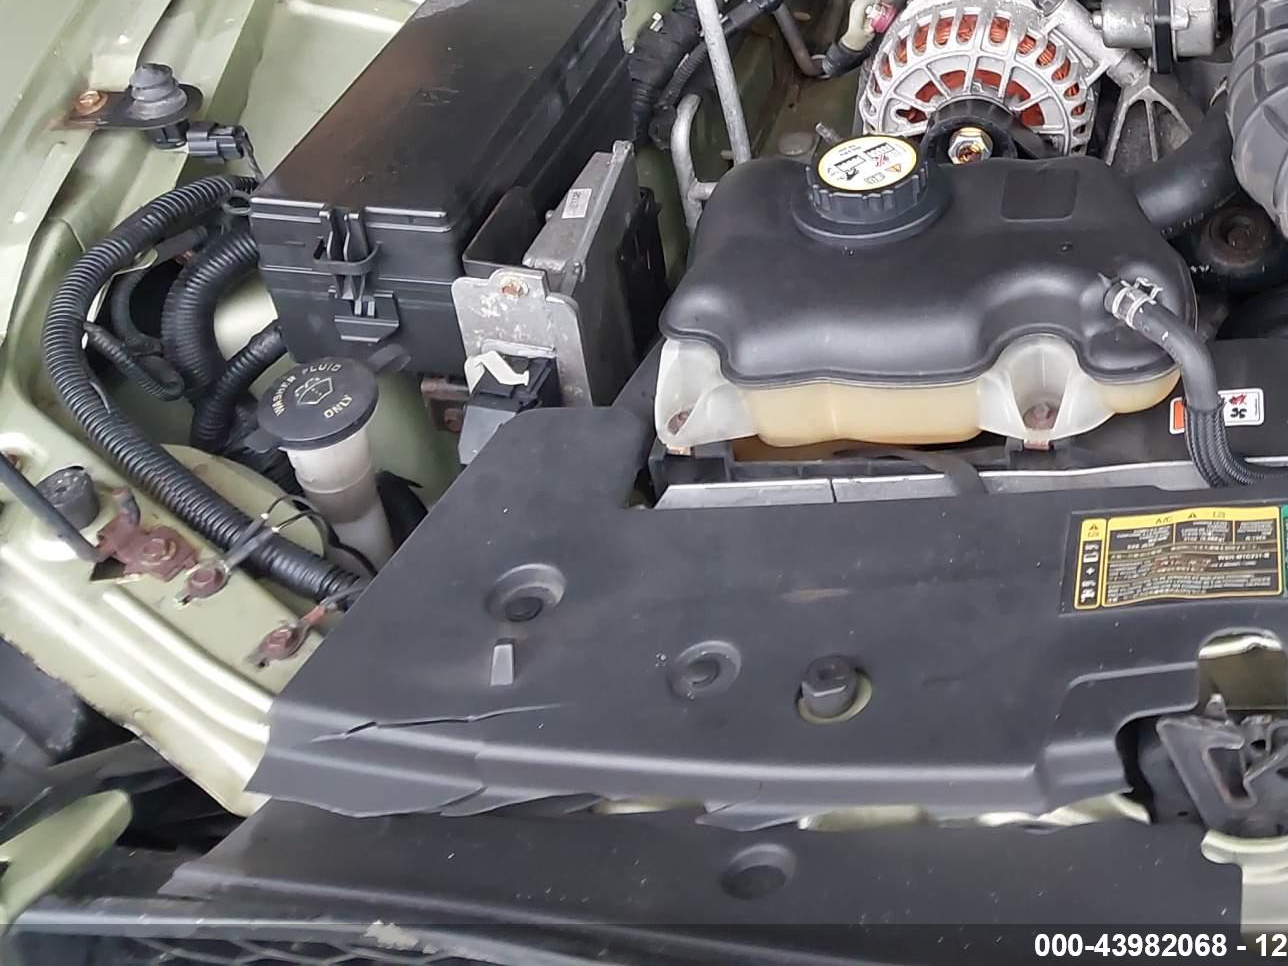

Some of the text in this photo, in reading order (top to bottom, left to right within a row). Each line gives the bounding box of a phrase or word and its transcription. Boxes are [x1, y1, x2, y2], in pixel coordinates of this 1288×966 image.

[271, 363, 342, 417] WASHER FLUID
[323, 394, 353, 419] ONLY
